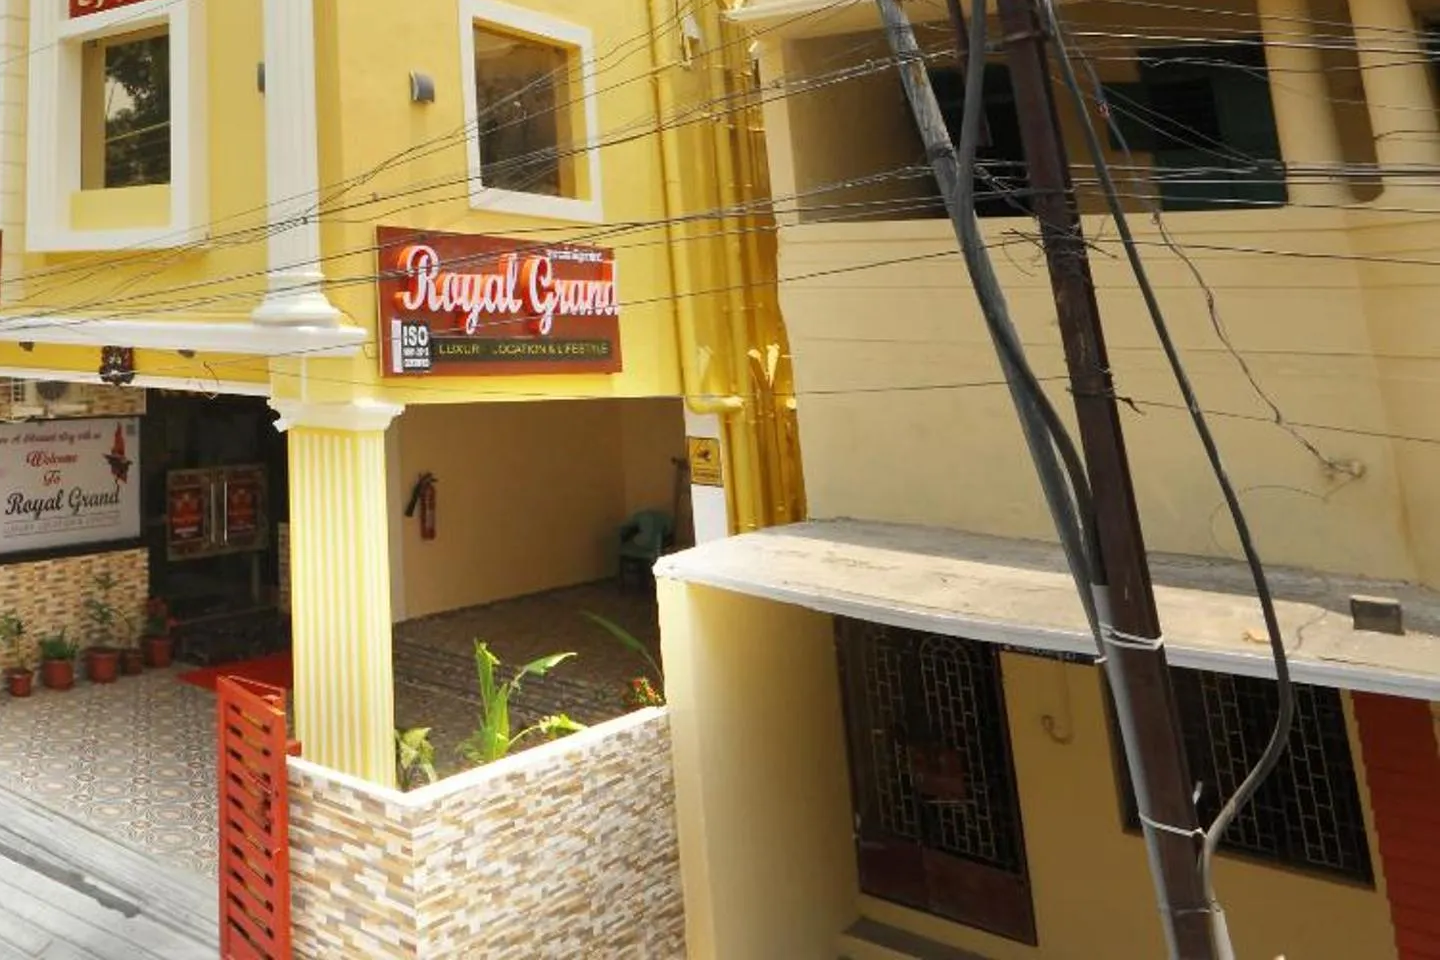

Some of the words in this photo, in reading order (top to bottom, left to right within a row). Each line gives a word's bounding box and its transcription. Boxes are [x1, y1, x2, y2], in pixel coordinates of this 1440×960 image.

[402, 244, 522, 335] Royal
[527, 254, 621, 336] Grand
[403, 325, 429, 346] ISO
[439, 343, 485, 355] LUXUR
[5, 489, 64, 520] Royal
[68, 486, 120, 515] Grand
